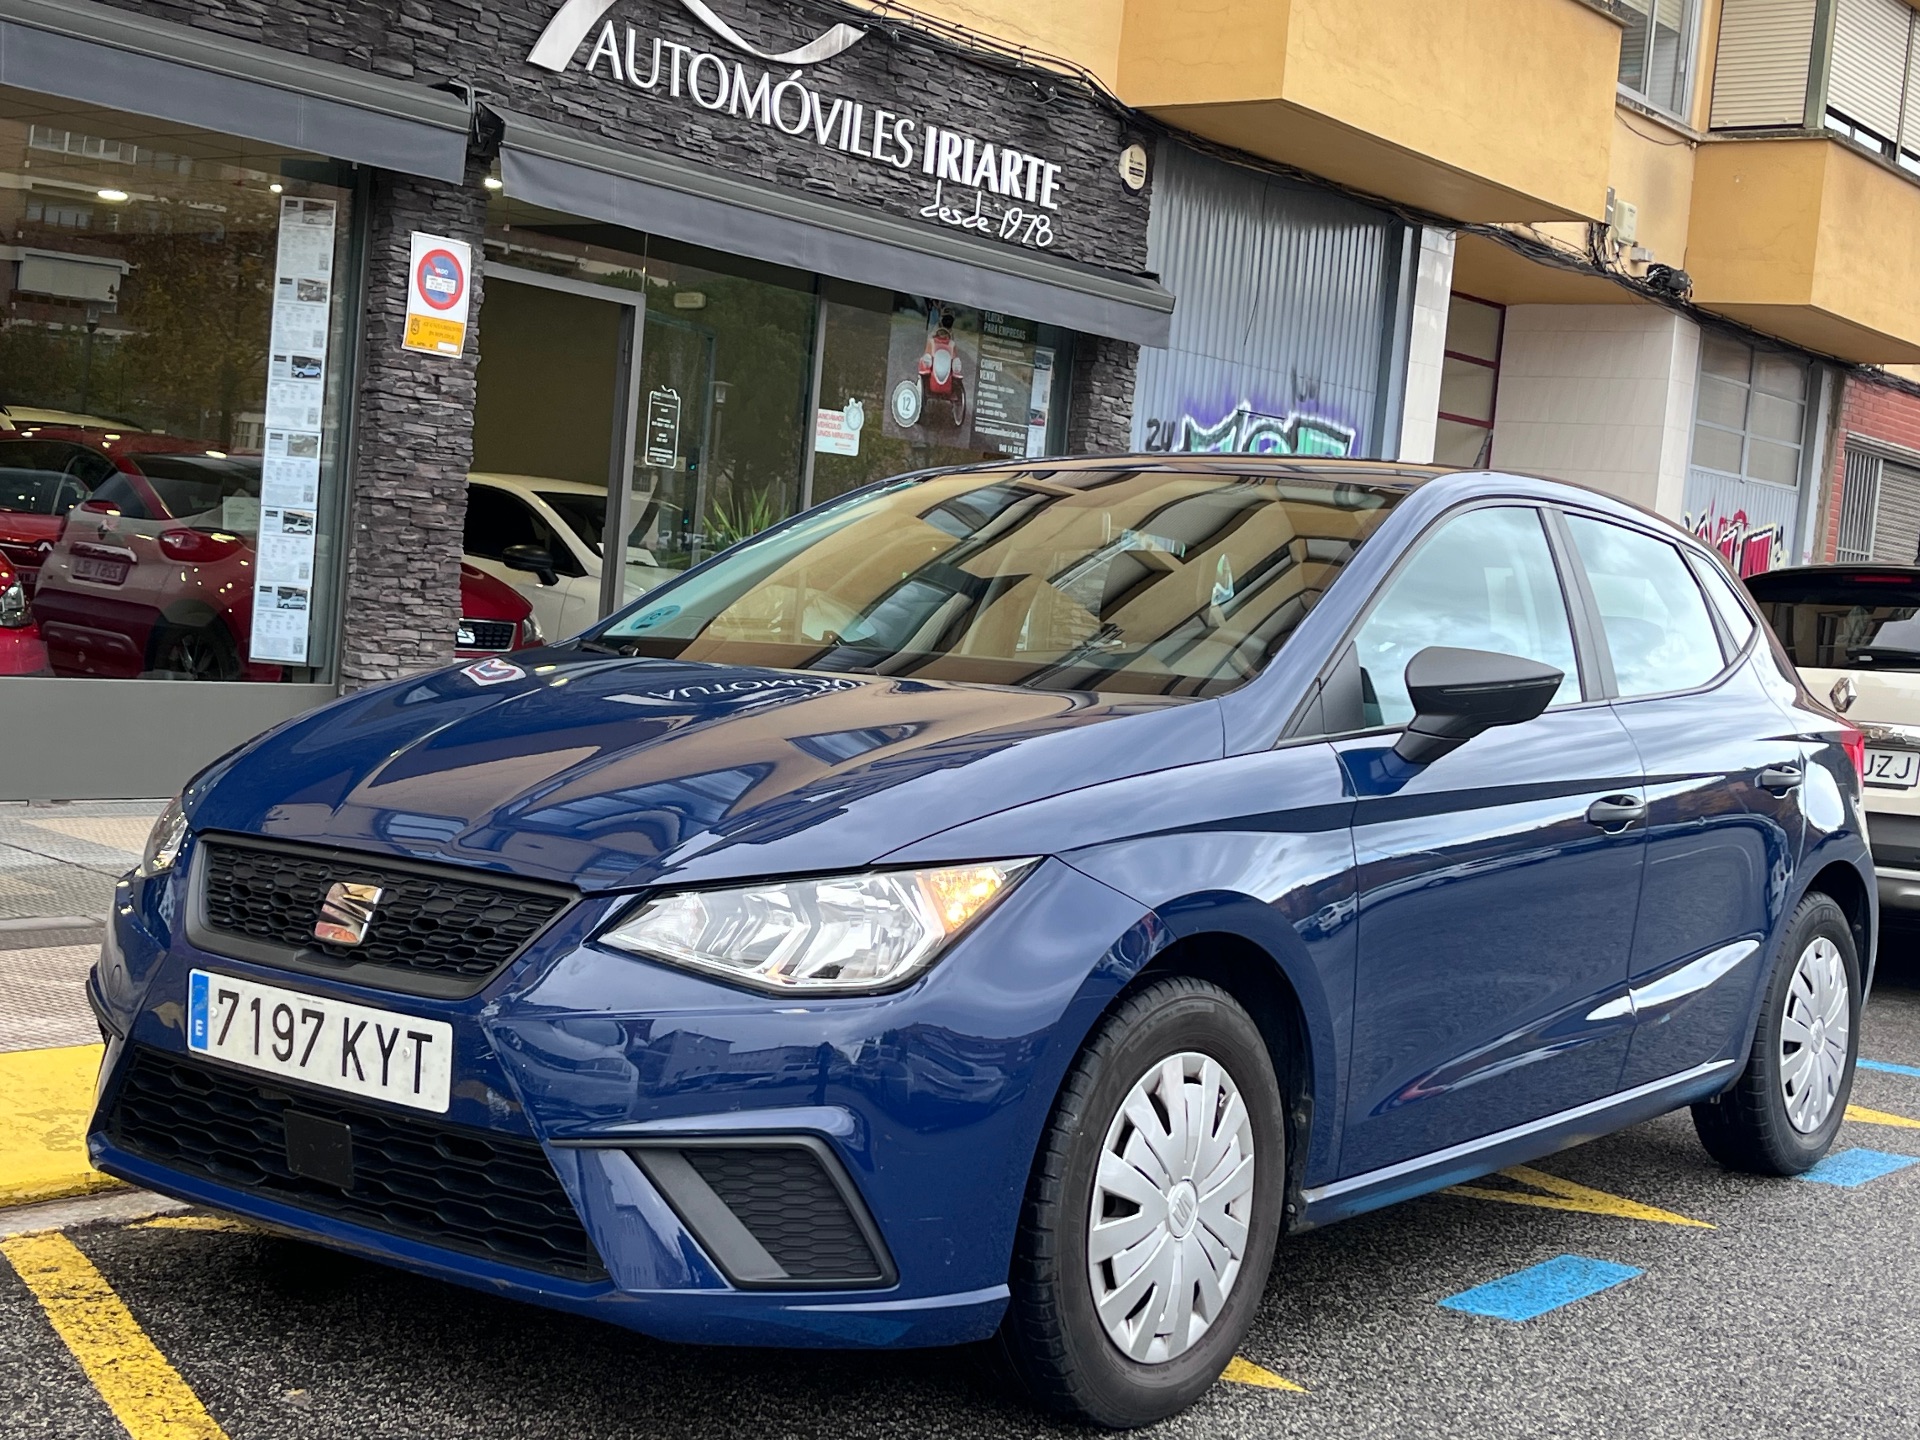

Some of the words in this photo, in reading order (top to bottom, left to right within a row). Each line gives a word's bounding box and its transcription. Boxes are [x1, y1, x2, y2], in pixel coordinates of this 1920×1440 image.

[585, 19, 916, 169] AUTOMÓVILES
[922, 125, 1062, 210] IRIARTE
[920, 180, 991, 233] desde
[999, 207, 1054, 247] 1978
[902, 396, 911, 411] 12
[216, 988, 325, 1068] 7197
[341, 1016, 433, 1094] KYT
